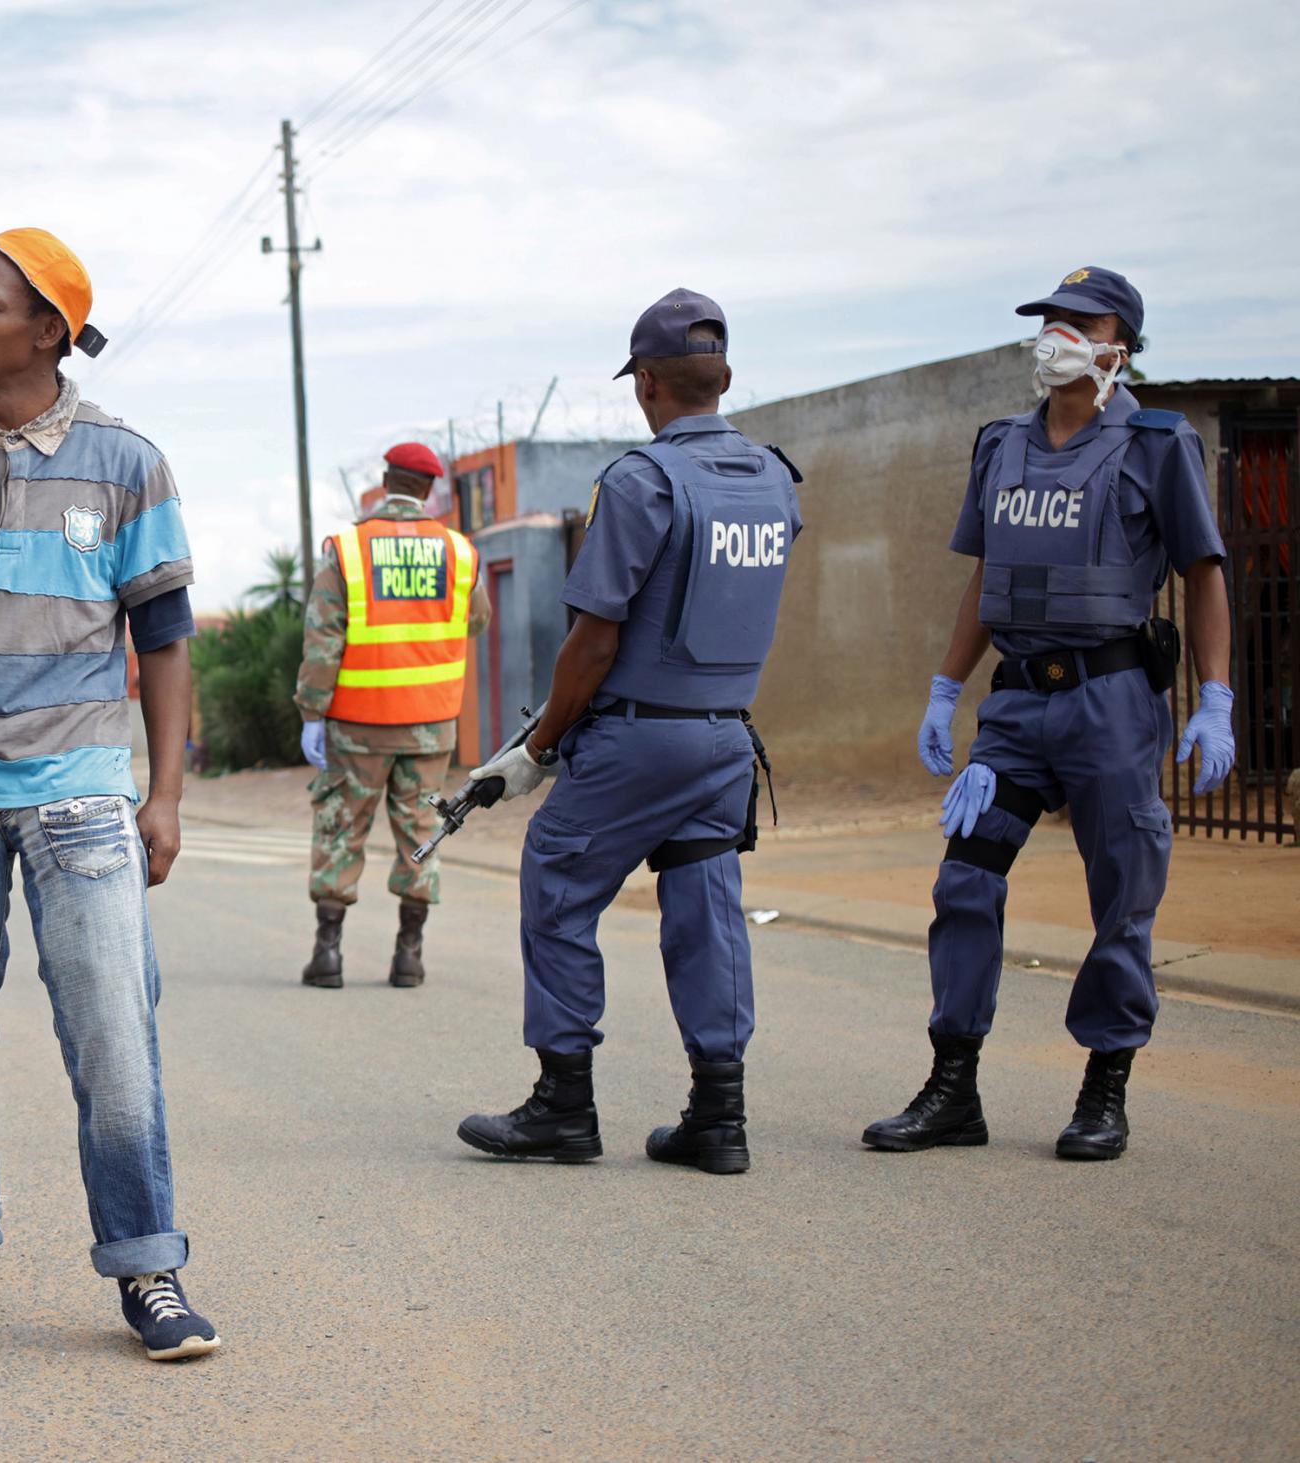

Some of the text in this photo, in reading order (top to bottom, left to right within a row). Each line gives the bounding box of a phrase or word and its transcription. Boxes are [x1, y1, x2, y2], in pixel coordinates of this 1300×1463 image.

[993, 488, 1084, 528] POLICE
[371, 538, 444, 566] MILITARY
[710, 520, 785, 567] POLICE
[382, 567, 437, 597] POLICE
